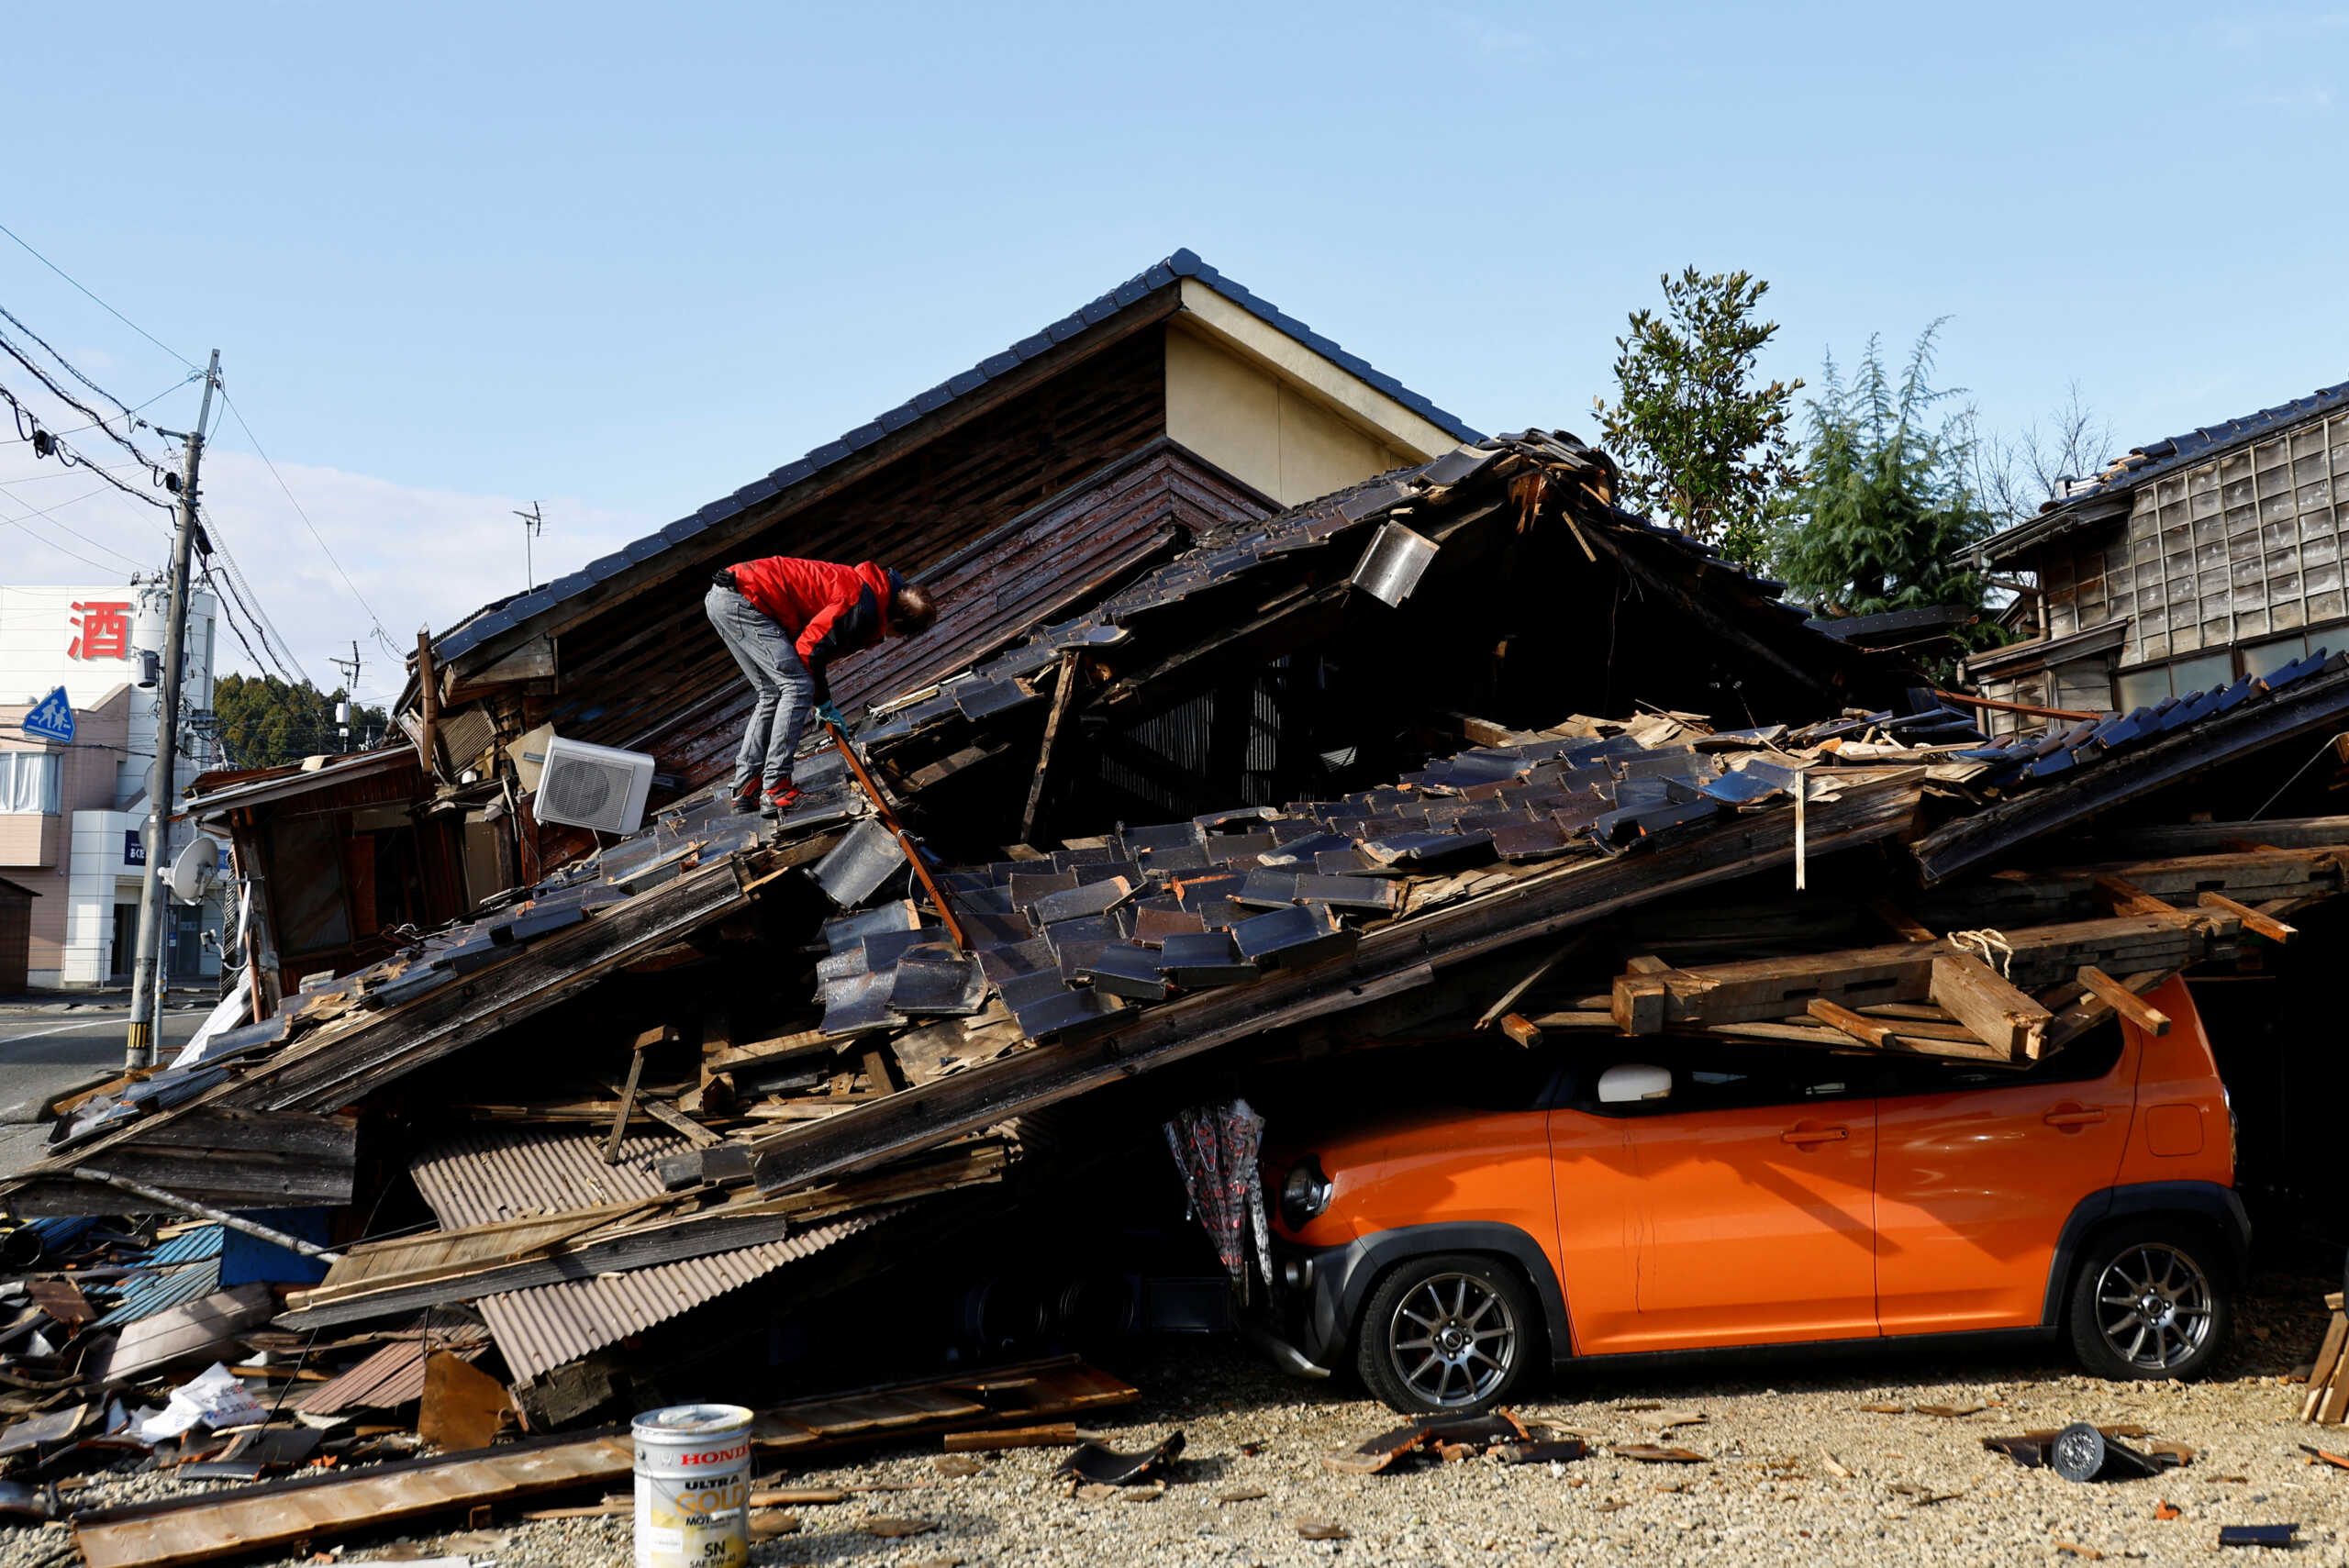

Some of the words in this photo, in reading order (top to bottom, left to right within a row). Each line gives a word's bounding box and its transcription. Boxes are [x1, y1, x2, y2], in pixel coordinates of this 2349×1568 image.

[67, 601, 131, 661] 酒
[685, 1474, 740, 1490] ULTRA
[675, 1483, 746, 1515] GOLD
[704, 1540, 726, 1558] SN
